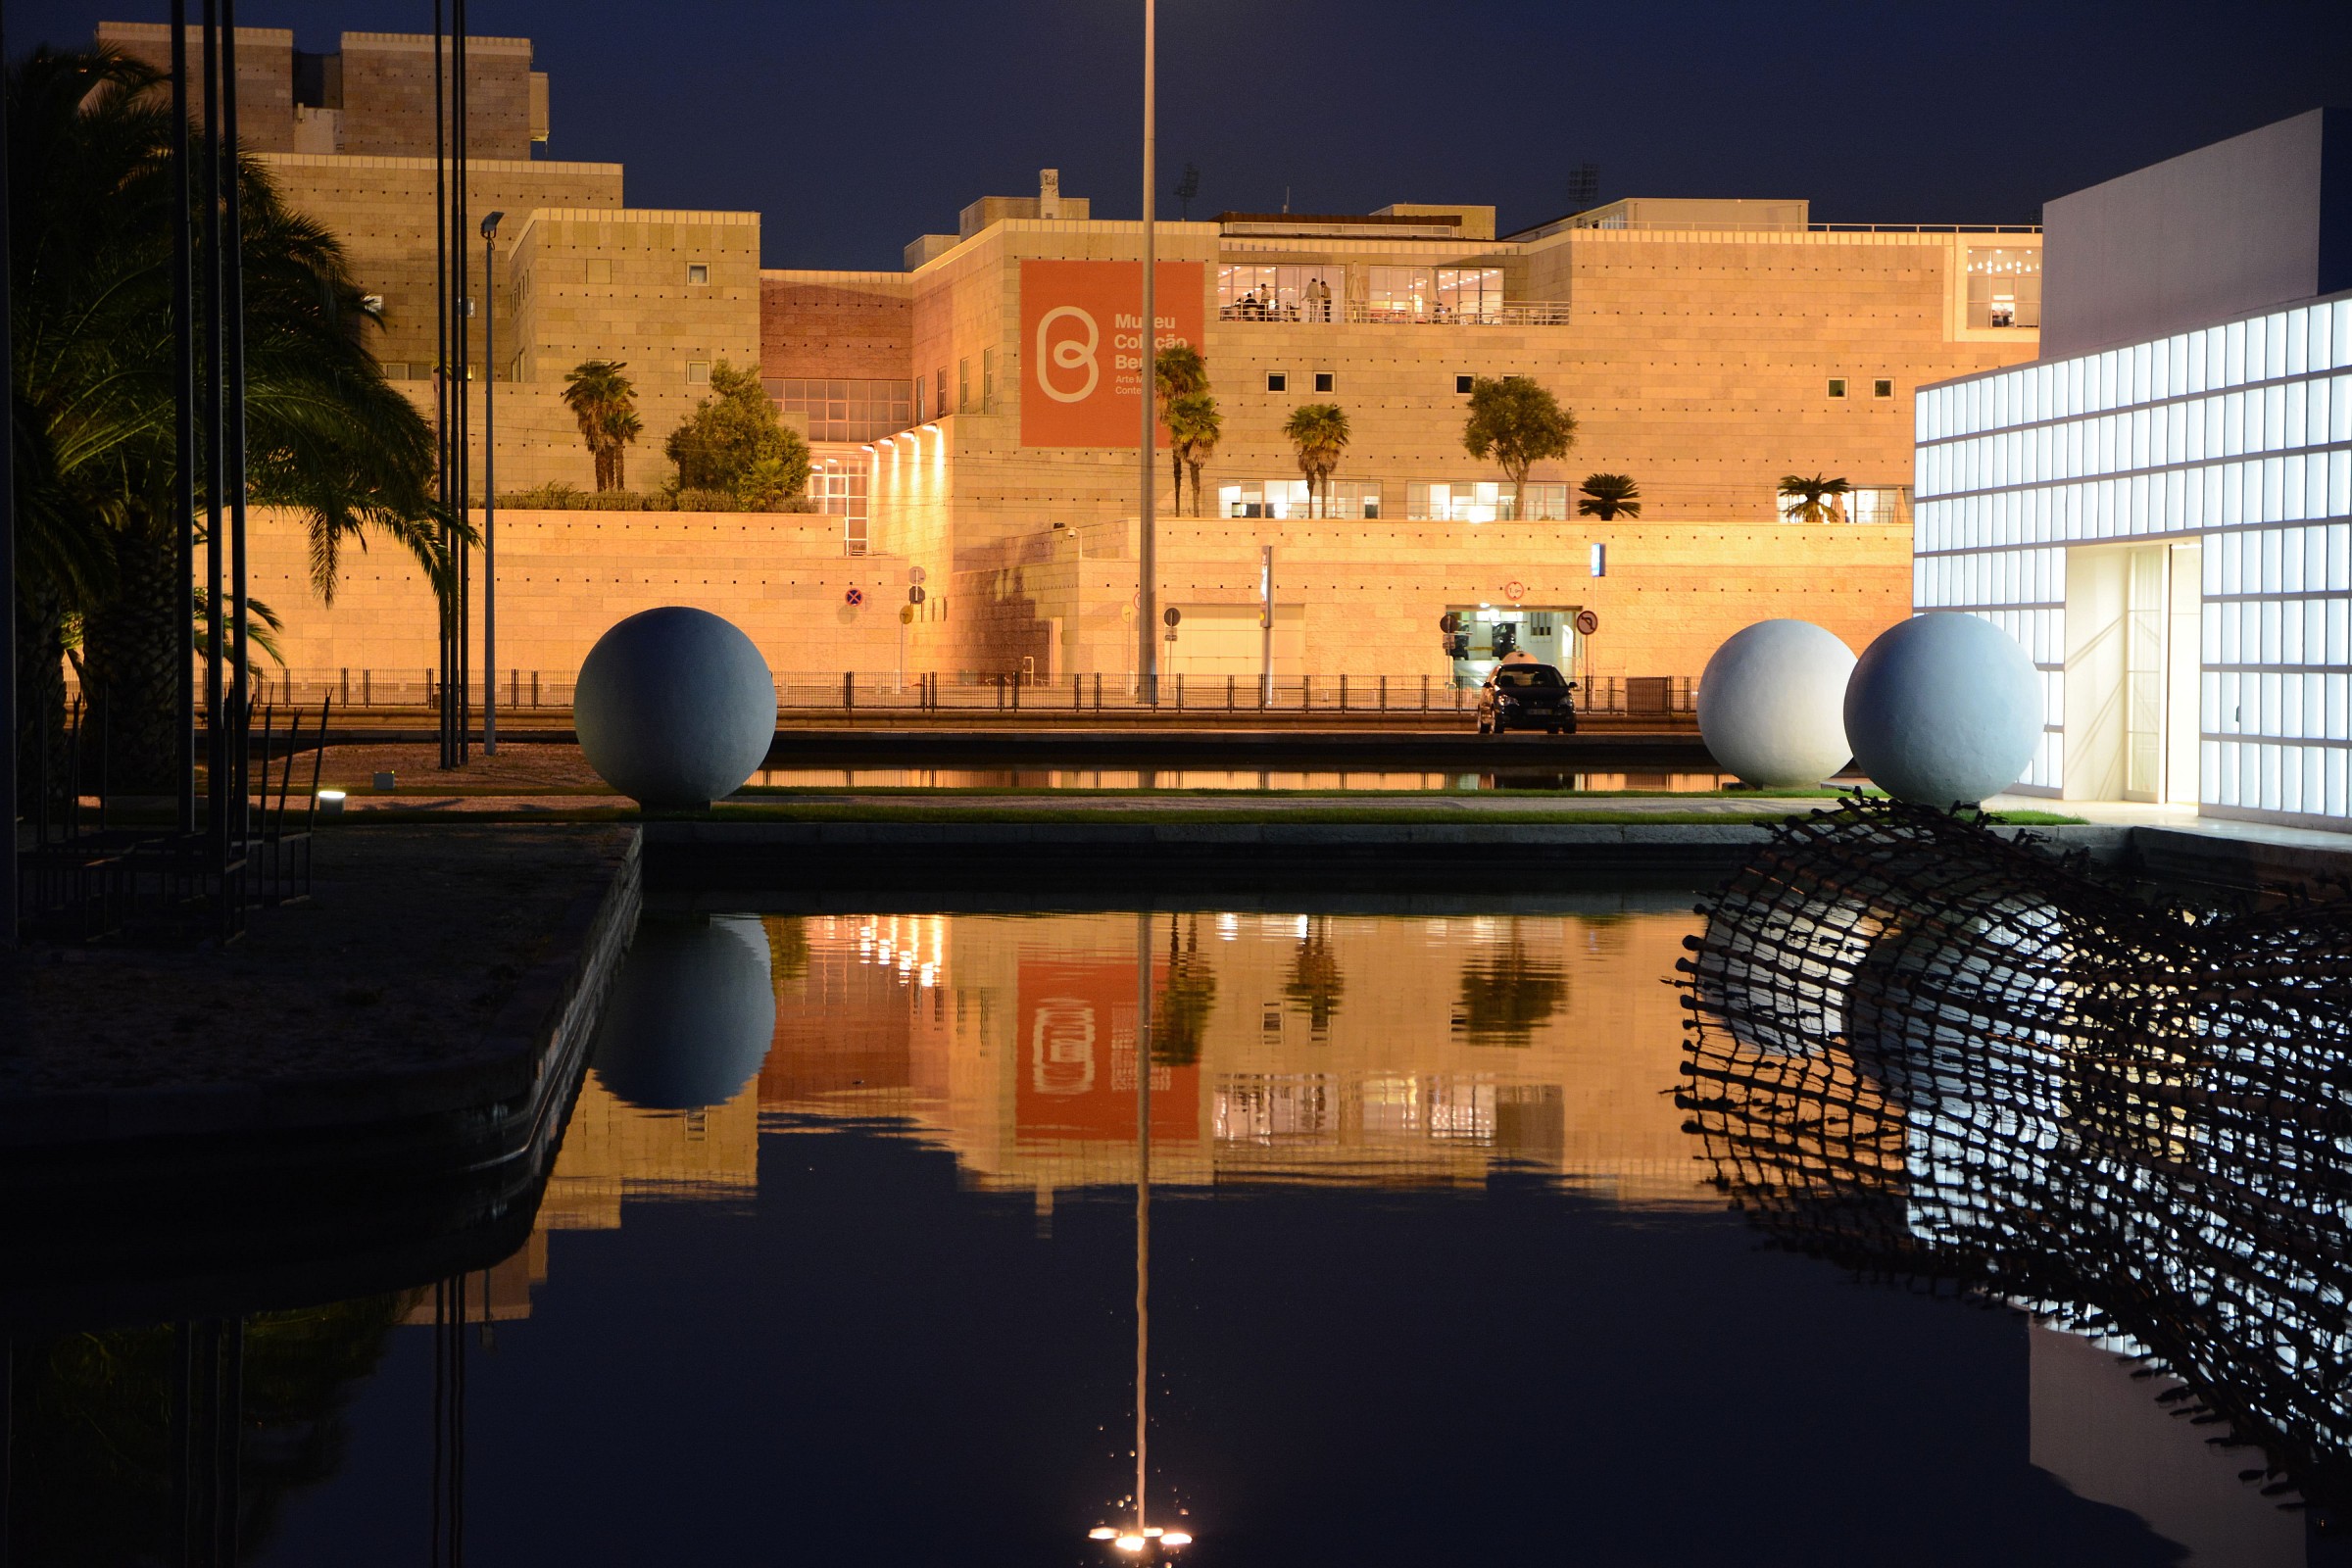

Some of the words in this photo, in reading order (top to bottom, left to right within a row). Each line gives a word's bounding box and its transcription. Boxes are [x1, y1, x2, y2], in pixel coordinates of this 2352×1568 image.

[1115, 314, 1176, 329] Mueu
[1114, 334, 1188, 352] Colção
[1115, 375, 1134, 384] Arte
